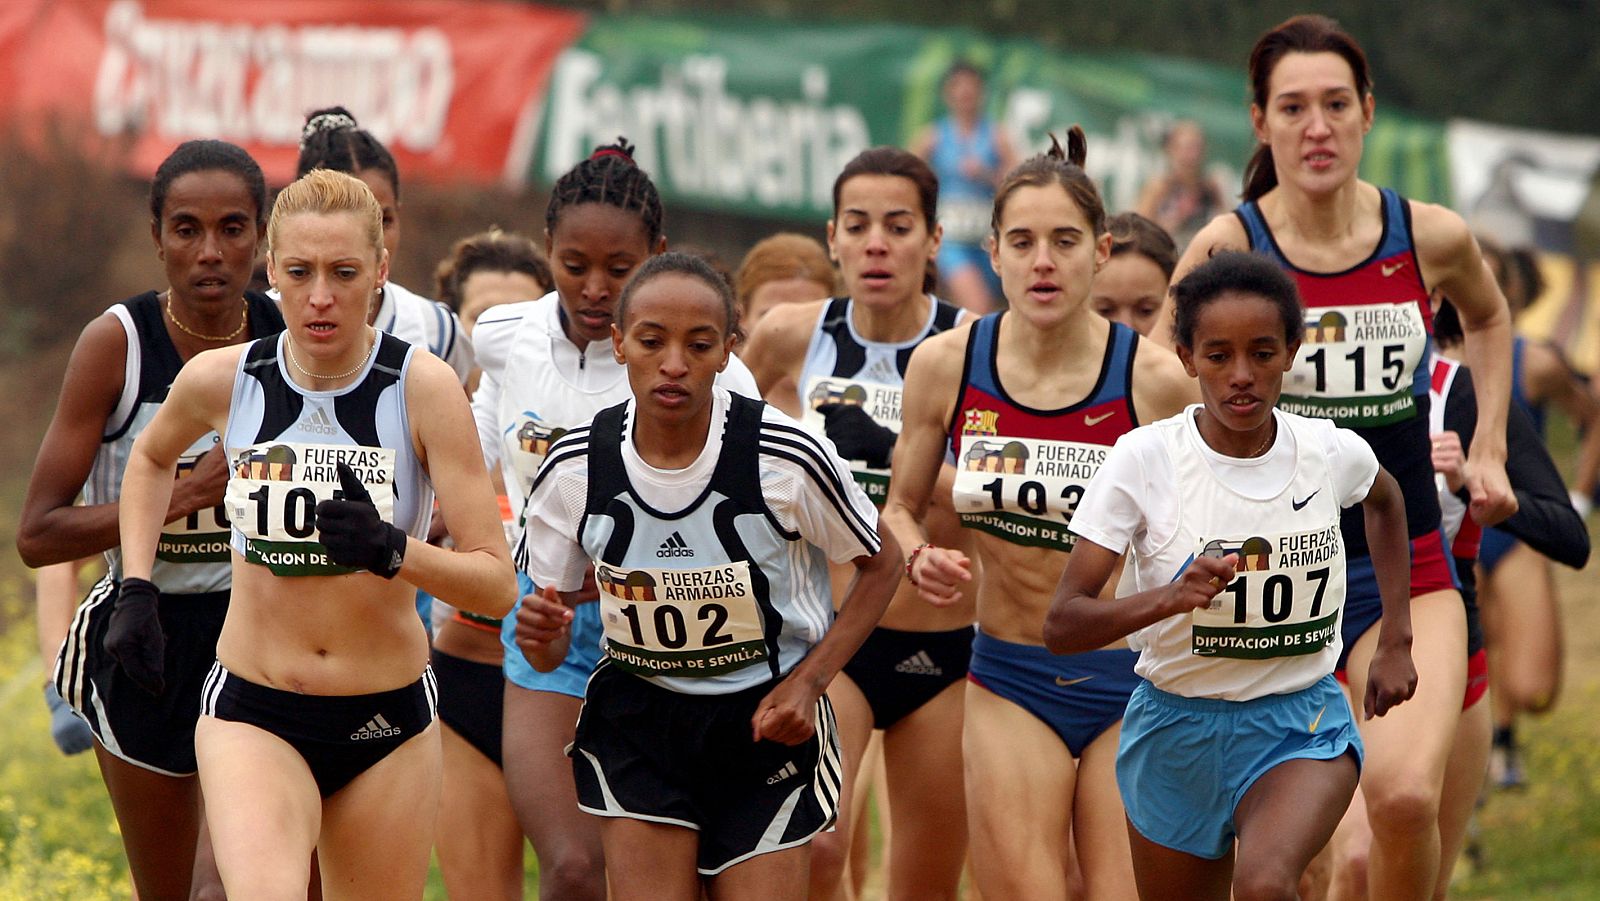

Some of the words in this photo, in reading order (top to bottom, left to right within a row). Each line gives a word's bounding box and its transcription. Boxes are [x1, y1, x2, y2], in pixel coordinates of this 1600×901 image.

[1354, 310, 1411, 326] FUERZS
[1306, 344, 1405, 392] 115
[1280, 402, 1359, 418] DIPUTACION
[1362, 405, 1379, 418] DE
[297, 422, 337, 435] adidas
[304, 448, 379, 468] FUERZAS
[1037, 444, 1107, 466] FUERZAS
[303, 465, 386, 485] ARMDAS
[1035, 461, 1100, 480] ARMAD
[982, 477, 1086, 523] 103
[249, 485, 347, 539] 10
[962, 514, 1037, 537] DIPUTACION
[1041, 528, 1058, 541] DE
[158, 542, 231, 554] IPUTACION
[1279, 525, 1336, 553] FUERZAS
[309, 552, 328, 566] DE
[656, 547, 694, 558] adidas
[1279, 539, 1339, 569] ARMADAS
[662, 567, 735, 587] FUERZAS
[665, 583, 746, 601] ARMADAS
[1225, 566, 1330, 624] 107
[620, 603, 734, 649] 102
[1195, 635, 1279, 649] DIPUTACION
[1284, 634, 1301, 646] DE
[610, 648, 682, 670] DIPUTACION
[687, 659, 705, 669] DE
[709, 649, 763, 667] SEVILLA
[350, 727, 401, 741] adidas
